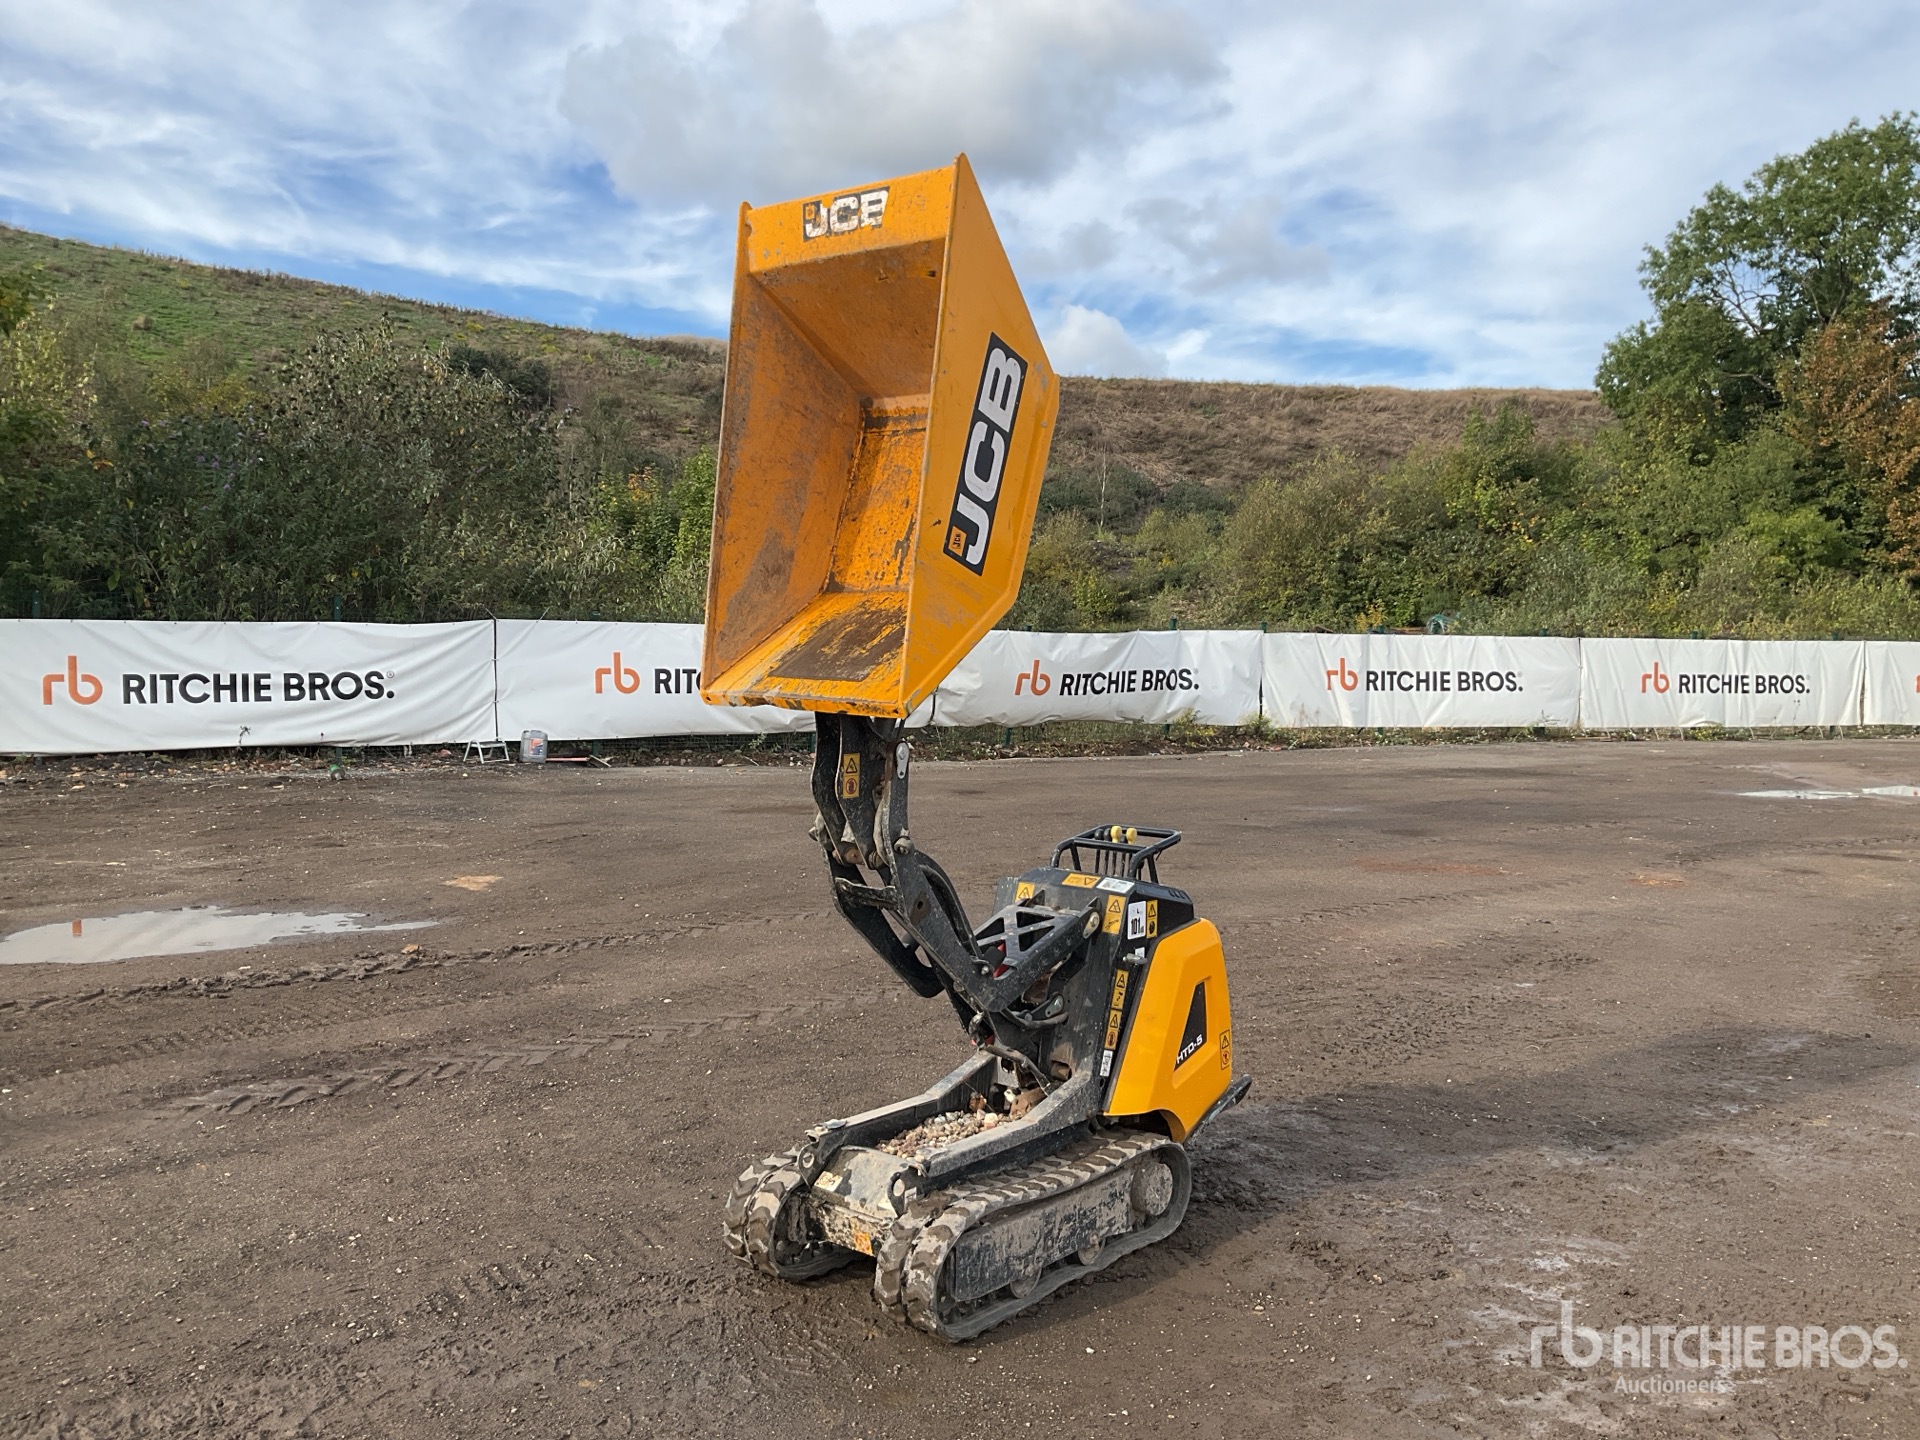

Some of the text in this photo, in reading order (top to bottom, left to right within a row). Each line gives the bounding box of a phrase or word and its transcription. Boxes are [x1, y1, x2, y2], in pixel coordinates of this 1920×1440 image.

[954, 348, 1021, 565] JCB
[122, 673, 271, 704] RITCHIE
[283, 670, 394, 702] BROS.
[654, 668, 701, 694] RIT
[1059, 671, 1137, 696] RITCHIE
[1141, 668, 1200, 692] BROS.
[1366, 670, 1450, 692] RITCHIE
[1457, 671, 1524, 692] BROS.
[1679, 674, 1750, 694] RITCHIE
[1755, 674, 1811, 694] BROS.
[1131, 917, 1141, 936] 101
[1176, 1034, 1203, 1064] HTD-5
